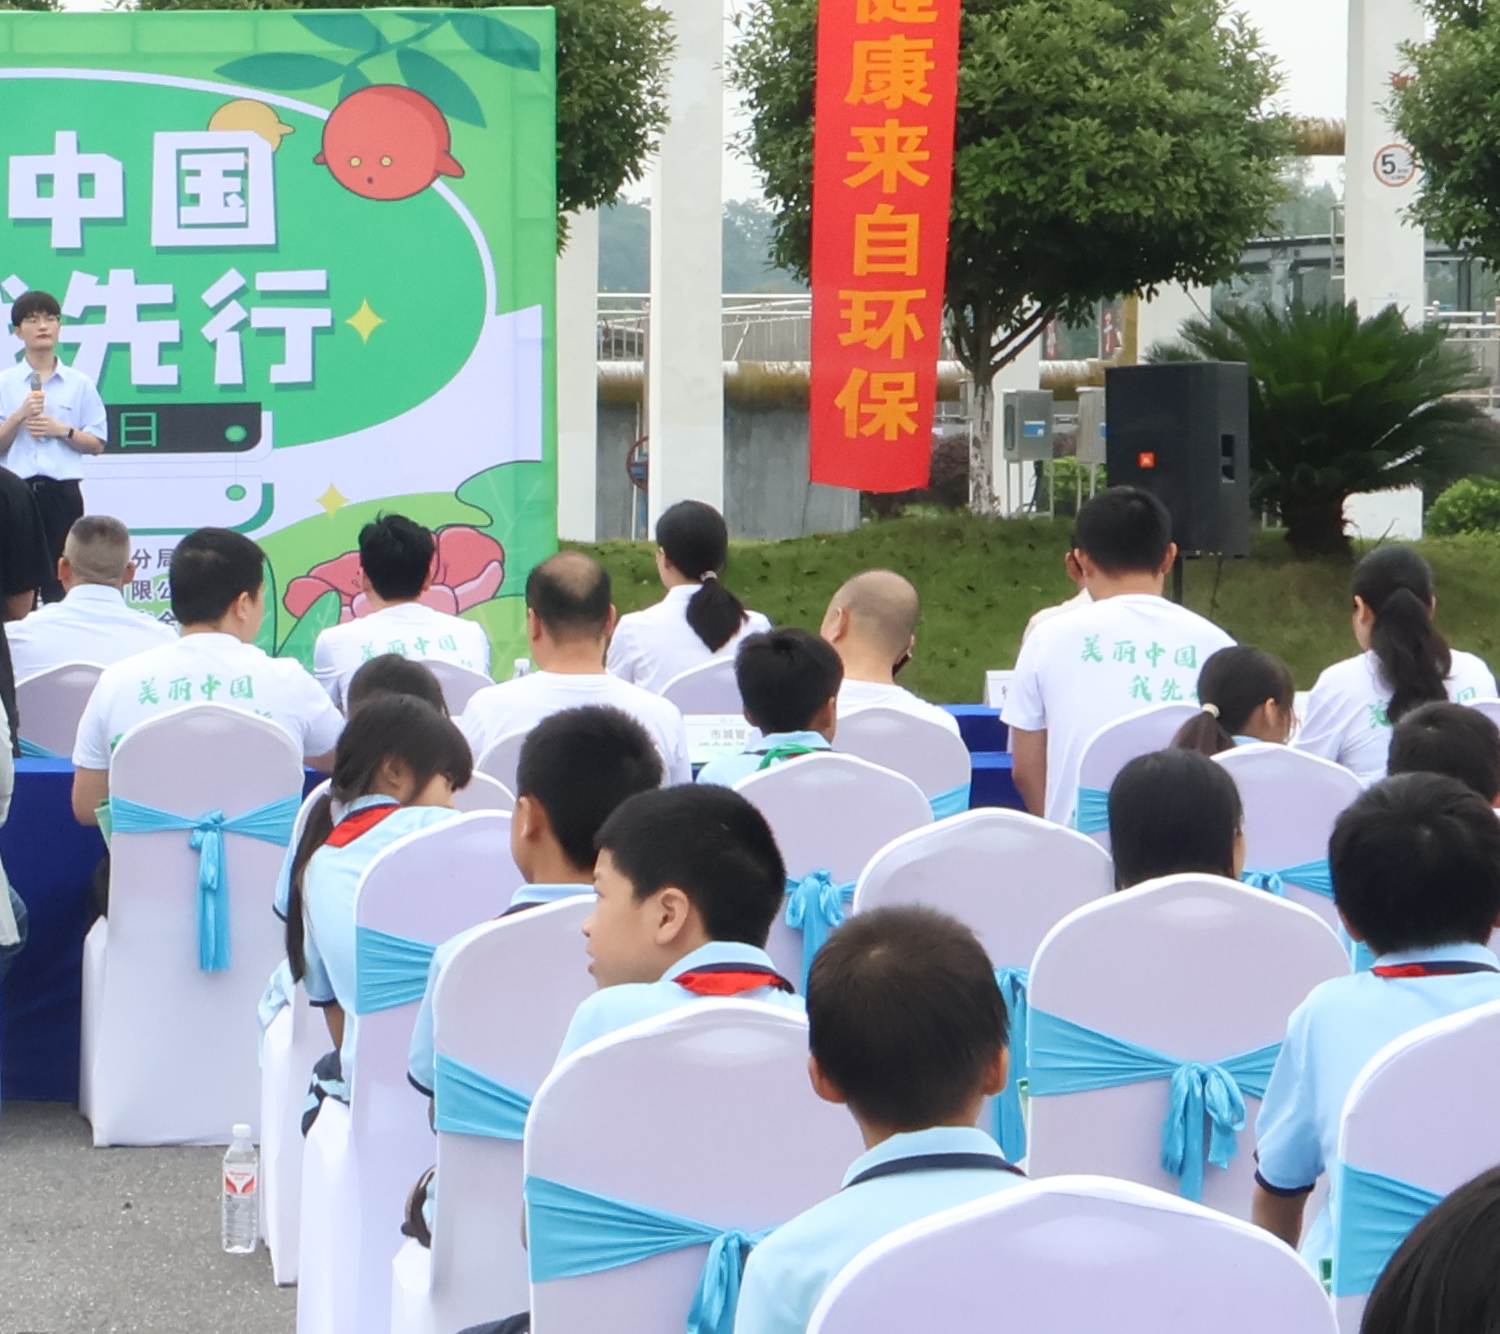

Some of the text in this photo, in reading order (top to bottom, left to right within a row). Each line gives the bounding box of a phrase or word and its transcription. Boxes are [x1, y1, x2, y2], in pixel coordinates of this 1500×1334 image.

[1080, 634, 1198, 670] 美丽中国
[138, 673, 255, 705] 美丽中国
[1128, 674, 1199, 703] 我先
